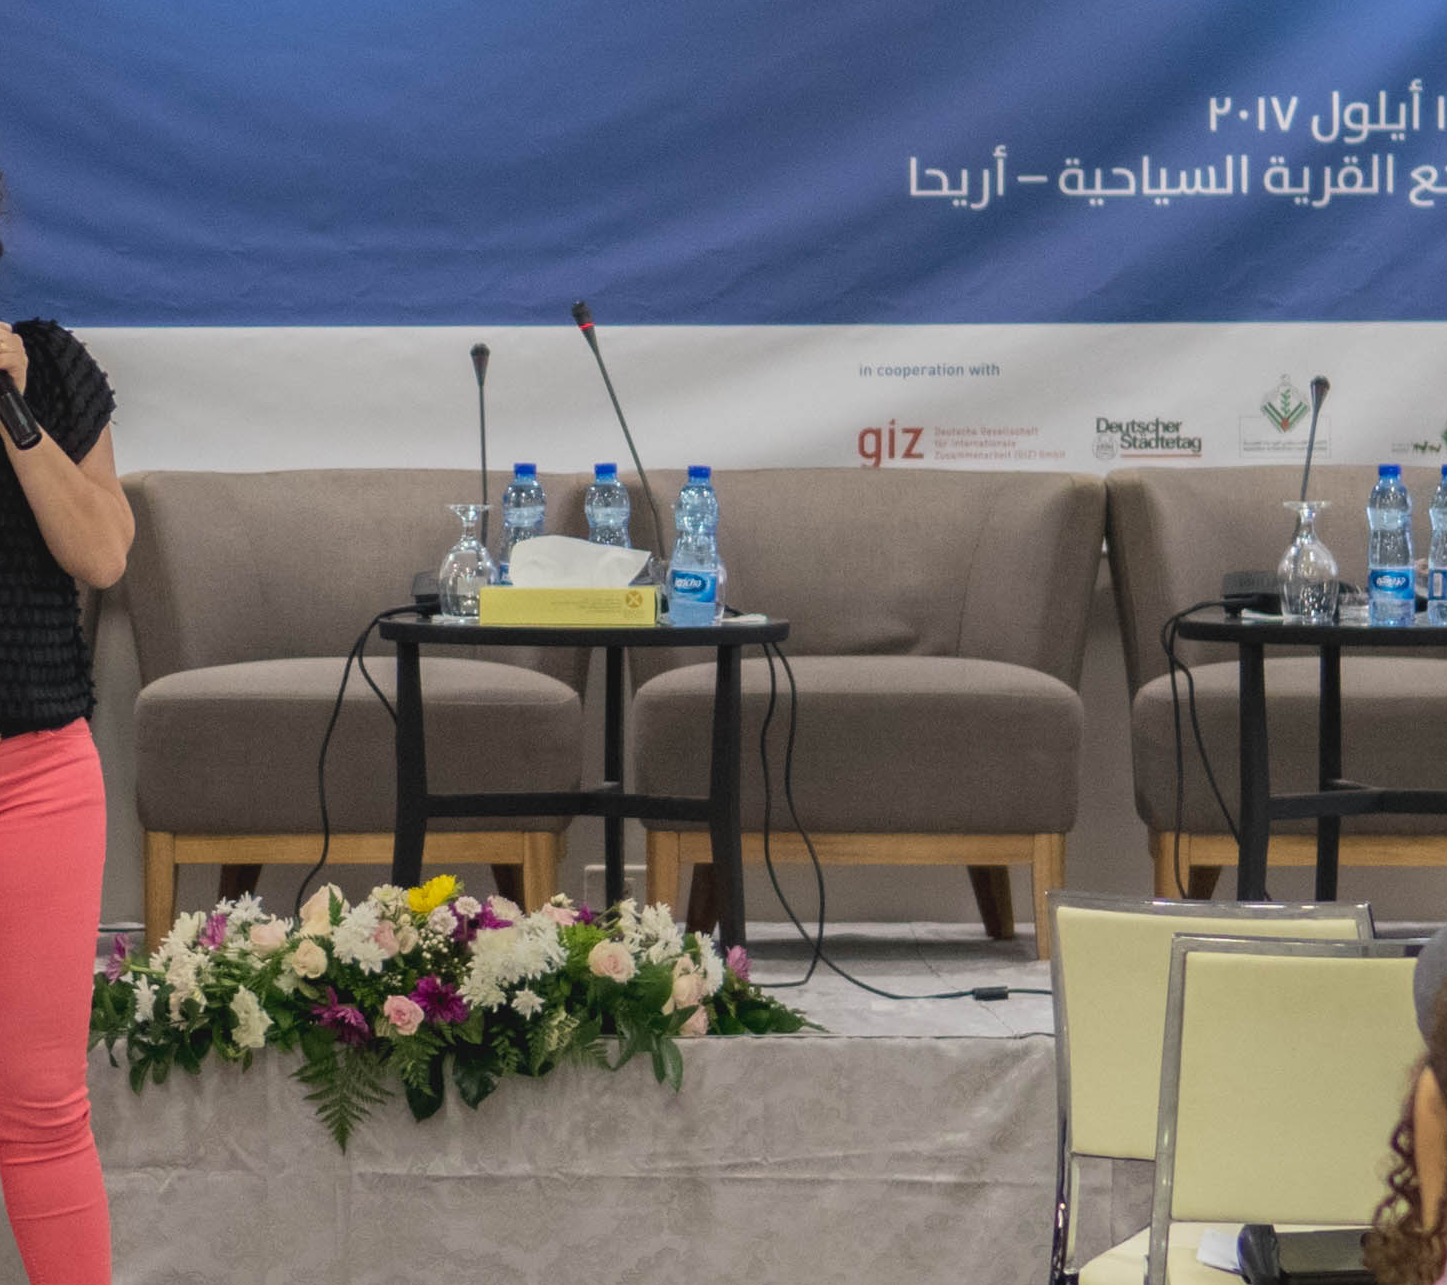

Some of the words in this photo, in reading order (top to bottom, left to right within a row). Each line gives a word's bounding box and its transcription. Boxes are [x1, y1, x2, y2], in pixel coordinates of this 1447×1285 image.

[1209, 95, 1299, 132] ٢٠١٧
[1311, 79, 1423, 144] أيلول
[909, 144, 1007, 209] أريحا
[1058, 154, 1248, 208] السياحية
[1263, 142, 1395, 208] القرية
[858, 365, 872, 377] in
[876, 363, 965, 379] cooperation
[968, 363, 1001, 377] with
[858, 418, 924, 468] giz
[1096, 417, 1183, 435] Deutscher
[1120, 431, 1203, 454] Städtetag
